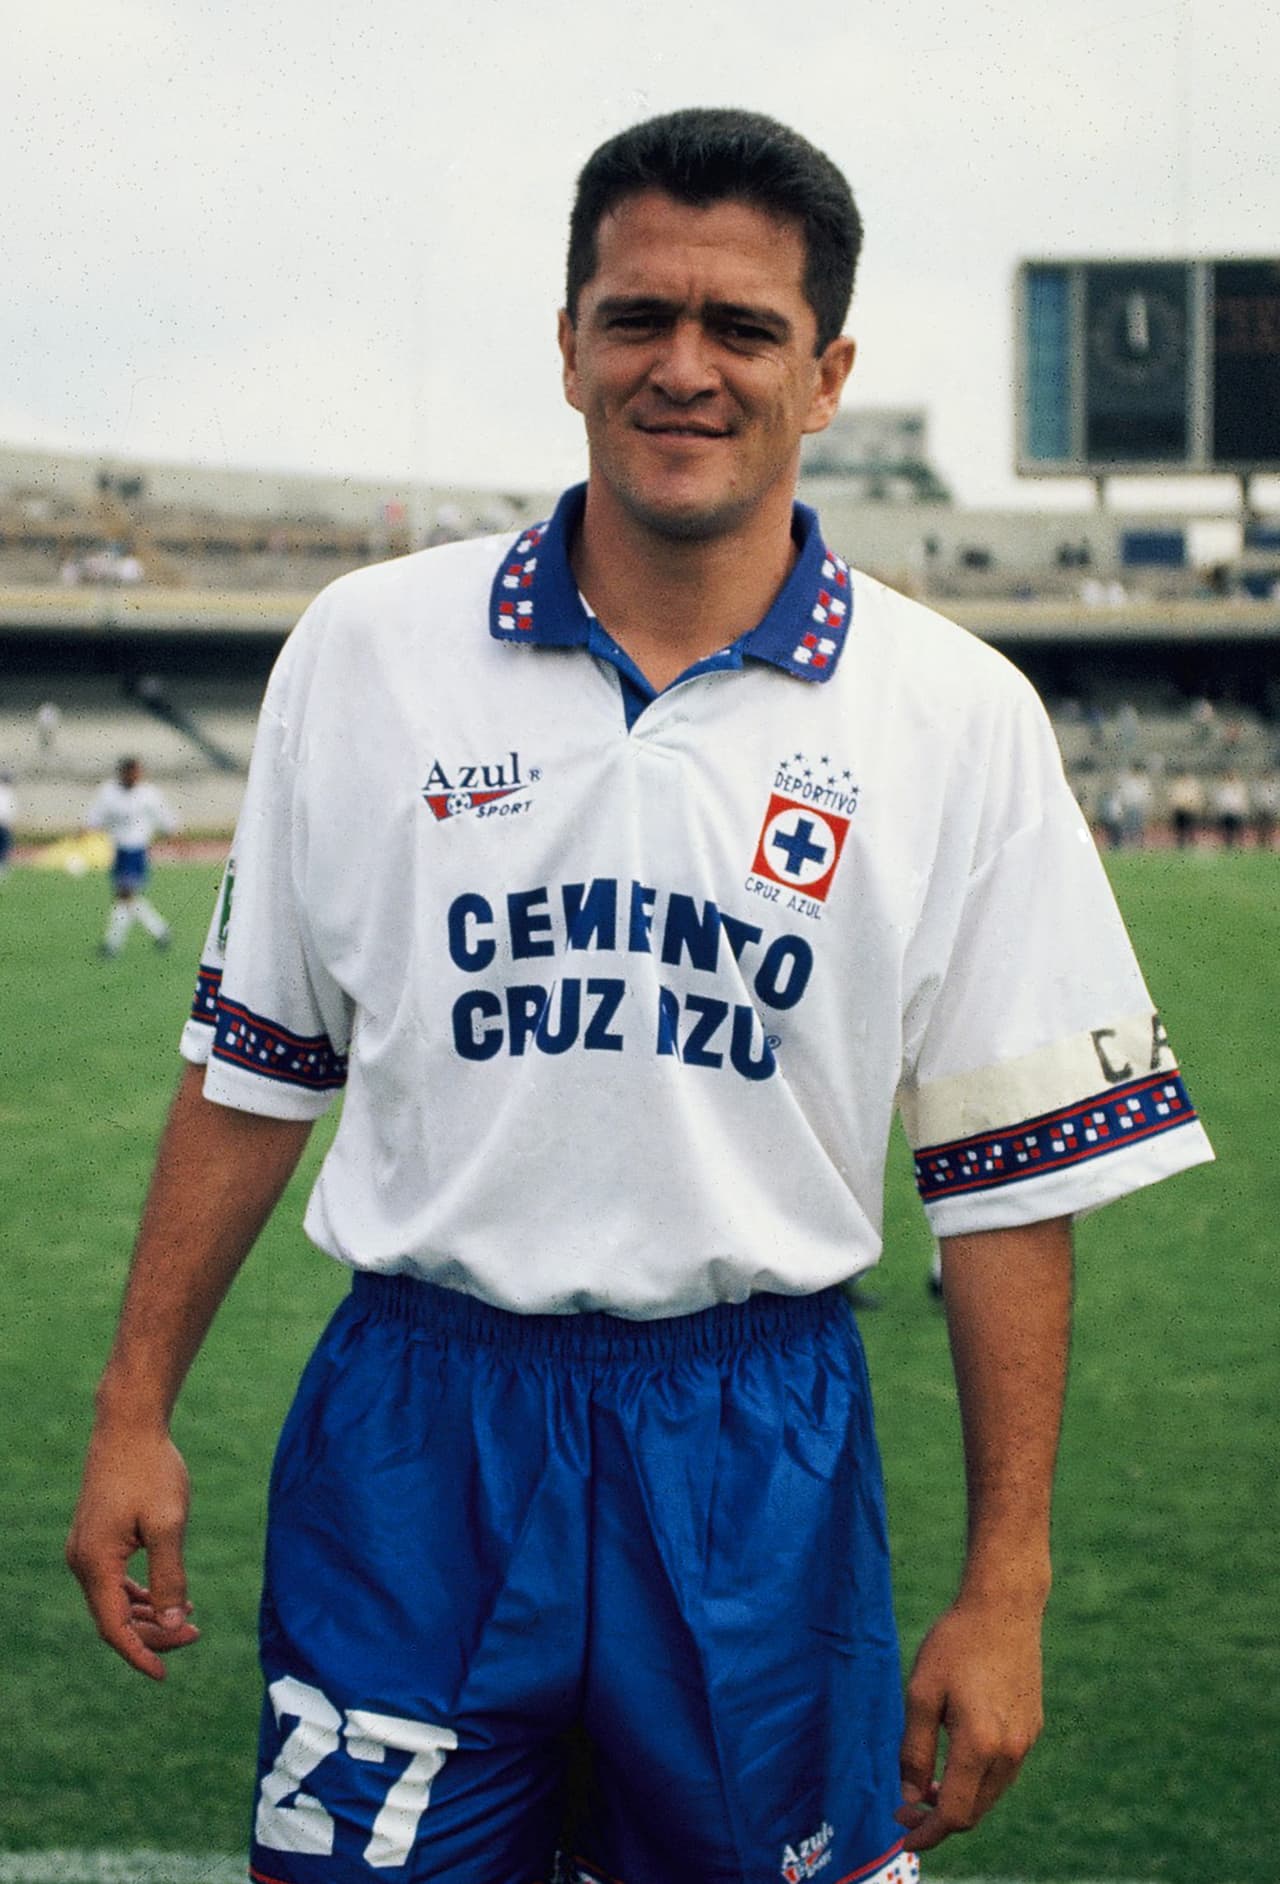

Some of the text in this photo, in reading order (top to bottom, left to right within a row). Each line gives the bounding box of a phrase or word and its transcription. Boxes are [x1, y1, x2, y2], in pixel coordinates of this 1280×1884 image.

[422, 752, 521, 790] Azul
[774, 771, 857, 815] DEPORTIVO
[476, 800, 533, 818] SPORT
[744, 877, 822, 920] CRUZ AZUL
[448, 878, 813, 1010] CEMENTO
[452, 978, 777, 1081] CRUZ AZU
[255, 1675, 458, 1868] 27
